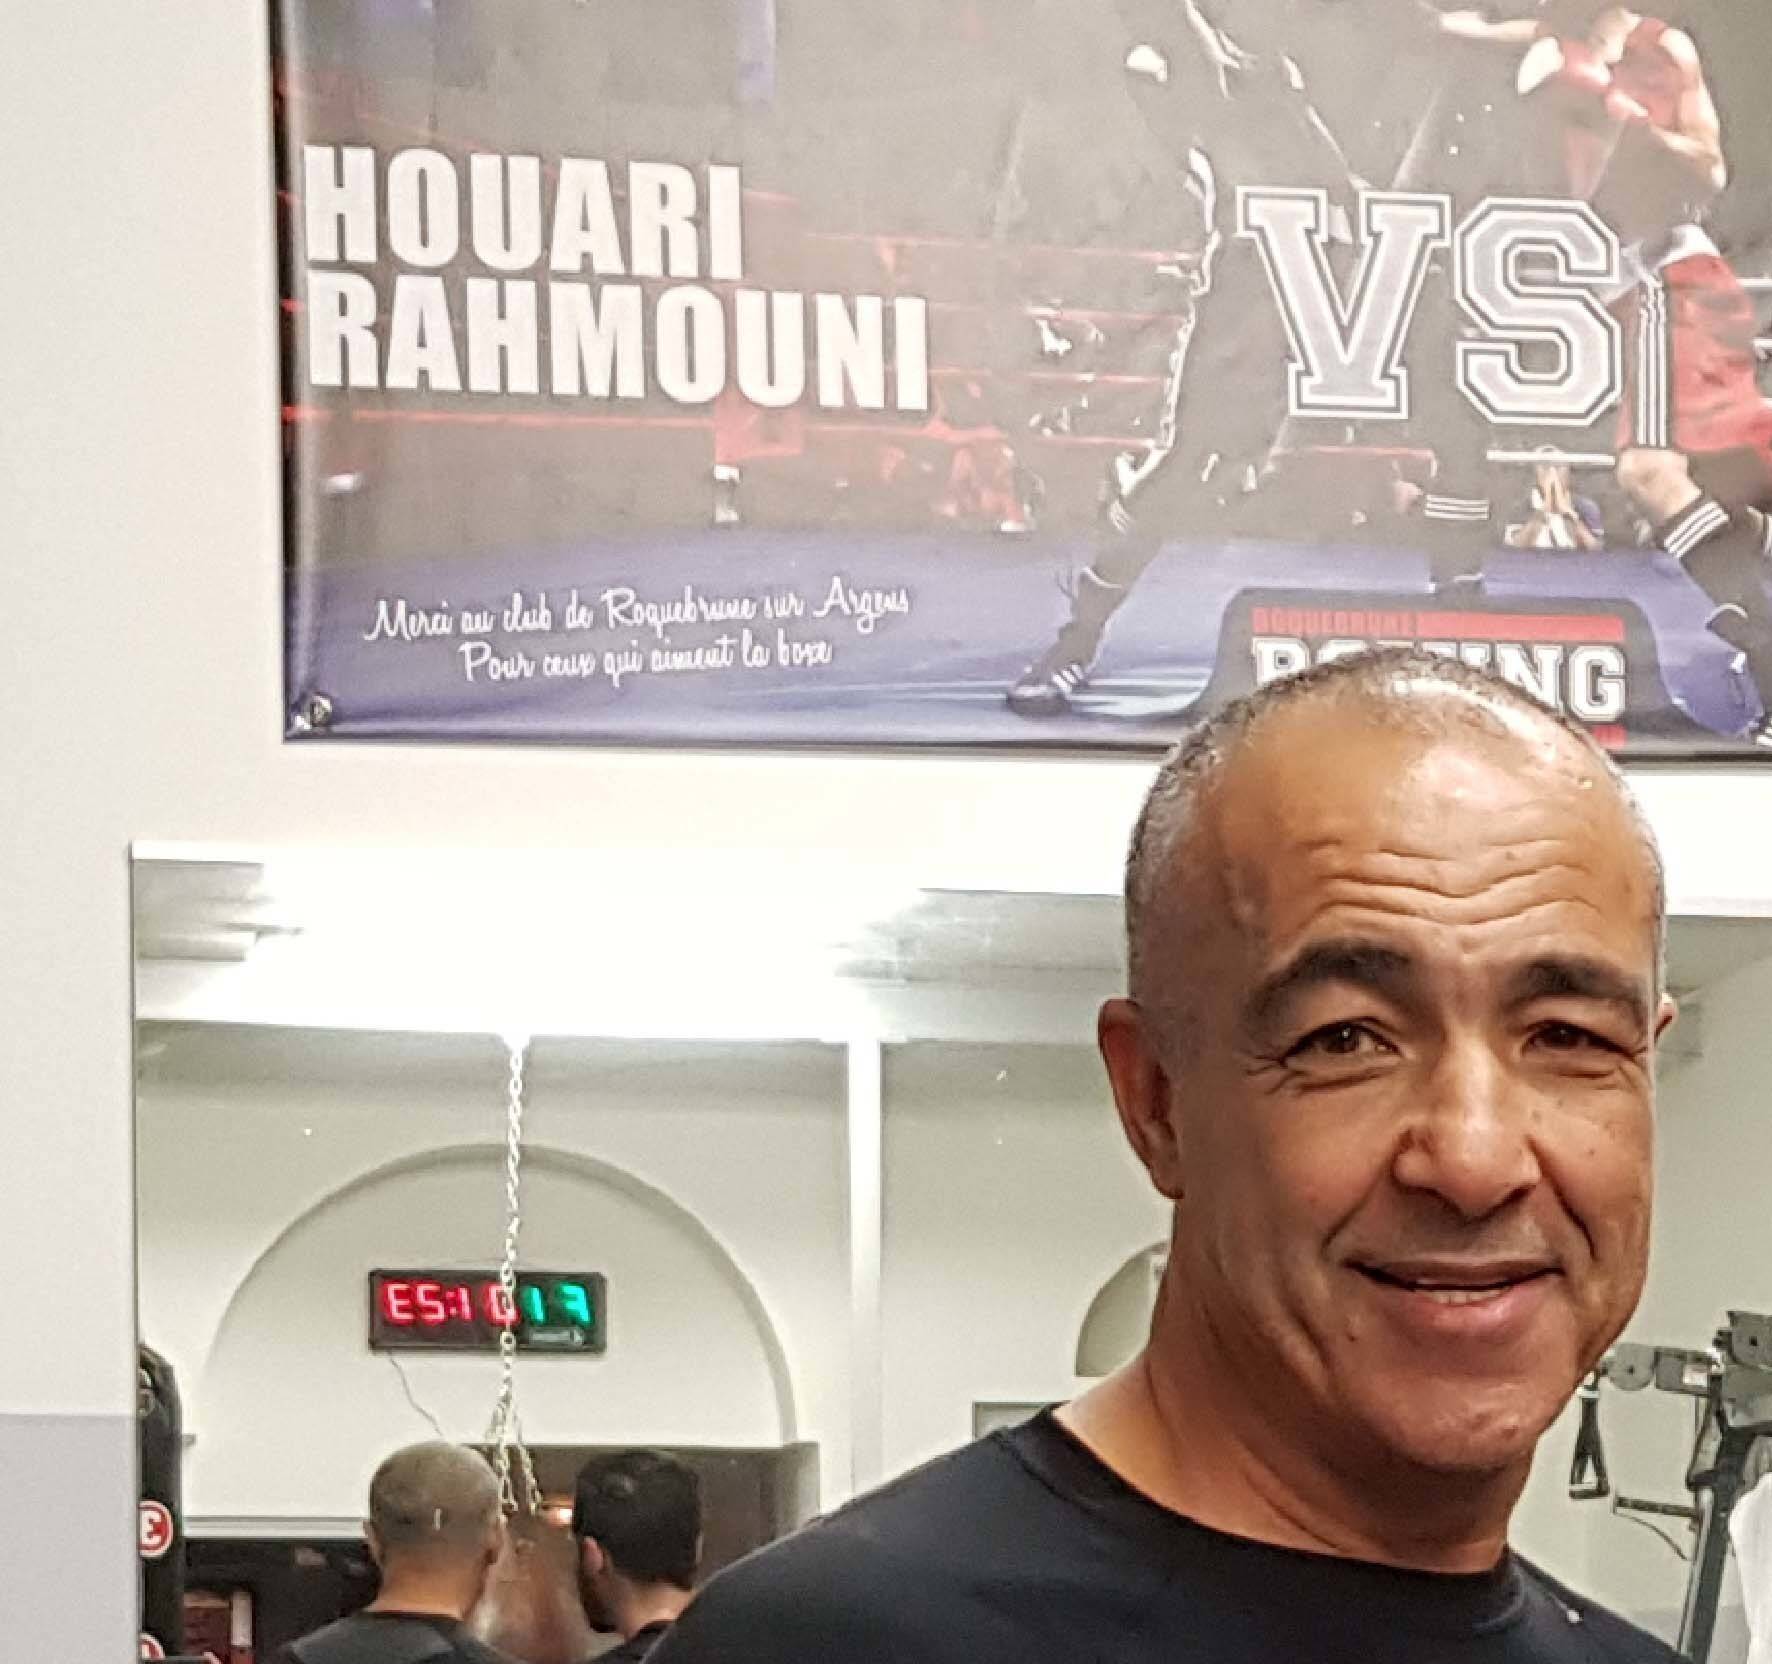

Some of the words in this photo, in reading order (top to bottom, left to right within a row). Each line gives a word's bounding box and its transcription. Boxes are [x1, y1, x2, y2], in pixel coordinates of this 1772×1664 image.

[304, 145, 744, 280] HOUARI
[308, 272, 928, 410] RAHMOUNI
[1237, 186, 1622, 426] VS
[363, 599, 453, 640] Merci
[461, 610, 497, 634] au
[503, 592, 551, 632] club
[566, 588, 594, 629] de
[600, 585, 756, 638] Roquebrune
[763, 592, 804, 618] sur
[457, 641, 537, 681] Pour
[542, 653, 597, 677] ceux
[603, 639, 644, 688] qui
[651, 633, 738, 672] aiment
[742, 628, 770, 667] la
[777, 628, 833, 667] boxe
